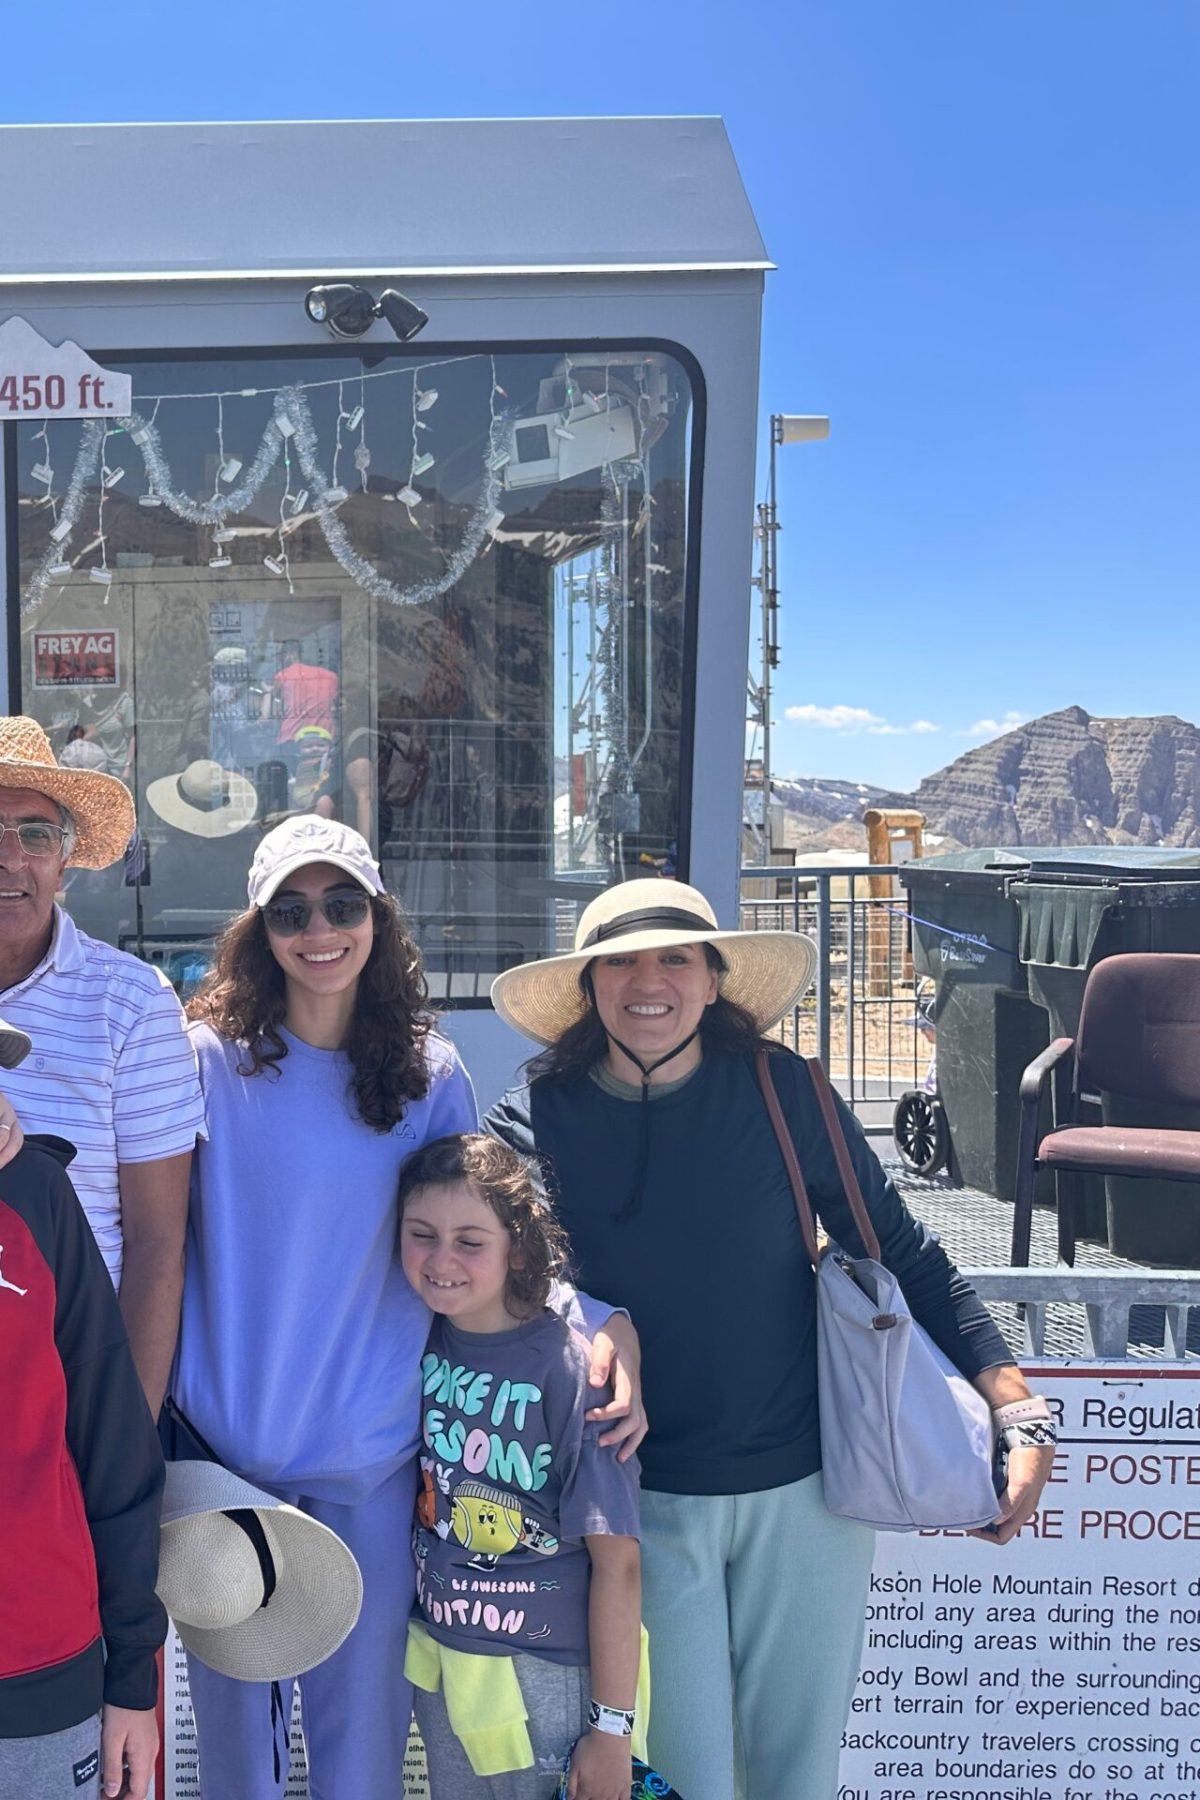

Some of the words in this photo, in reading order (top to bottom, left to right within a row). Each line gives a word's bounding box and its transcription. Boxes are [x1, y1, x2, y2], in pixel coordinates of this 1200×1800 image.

[78, 373, 114, 409] ft.
[37, 636, 83, 656] FREY
[84, 635, 113, 654] AG
[490, 1379, 542, 1432] IT
[1086, 1454, 1200, 1485] POSTE
[1080, 1509, 1200, 1540] PROCE
[451, 1578, 468, 1591] BE
[470, 1580, 536, 1593] AWESOME
[932, 1573, 982, 1594] Hole
[992, 1574, 1092, 1595] Mountain
[1102, 1575, 1177, 1596] Resort
[934, 1606, 975, 1627] any
[986, 1606, 1036, 1623] area
[1047, 1603, 1114, 1629] during
[1125, 1604, 1159, 1624] the
[868, 1628, 963, 1654] including
[974, 1633, 1037, 1650] areas
[1049, 1631, 1111, 1651] within
[1122, 1632, 1156, 1652] the
[1166, 1636, 1200, 1652] res
[857, 1665, 904, 1690] ody
[914, 1666, 969, 1687] Bowl
[978, 1667, 1020, 1687] and
[1030, 1667, 1065, 1688] the
[1075, 1669, 1200, 1695] surrounding
[851, 1694, 882, 1713] ert
[894, 1694, 964, 1714] terrain
[975, 1694, 1005, 1715] for
[1015, 1696, 1150, 1720] experienced
[1160, 1697, 1200, 1717] bac
[981, 1731, 1077, 1752] travelers
[1086, 1733, 1179, 1758] crossing
[873, 1761, 925, 1778] area
[935, 1758, 1058, 1779] boundaries
[1068, 1759, 1096, 1780] do
[1106, 1763, 1134, 1781] so
[1143, 1762, 1165, 1781] at
[1176, 1761, 1200, 1781] th
[880, 1789, 916, 1800] are
[926, 1786, 1052, 1800] responsible
[1063, 1787, 1093, 1800] for
[1105, 1787, 1138, 1800] the
[1149, 1790, 1197, 1800] cost
